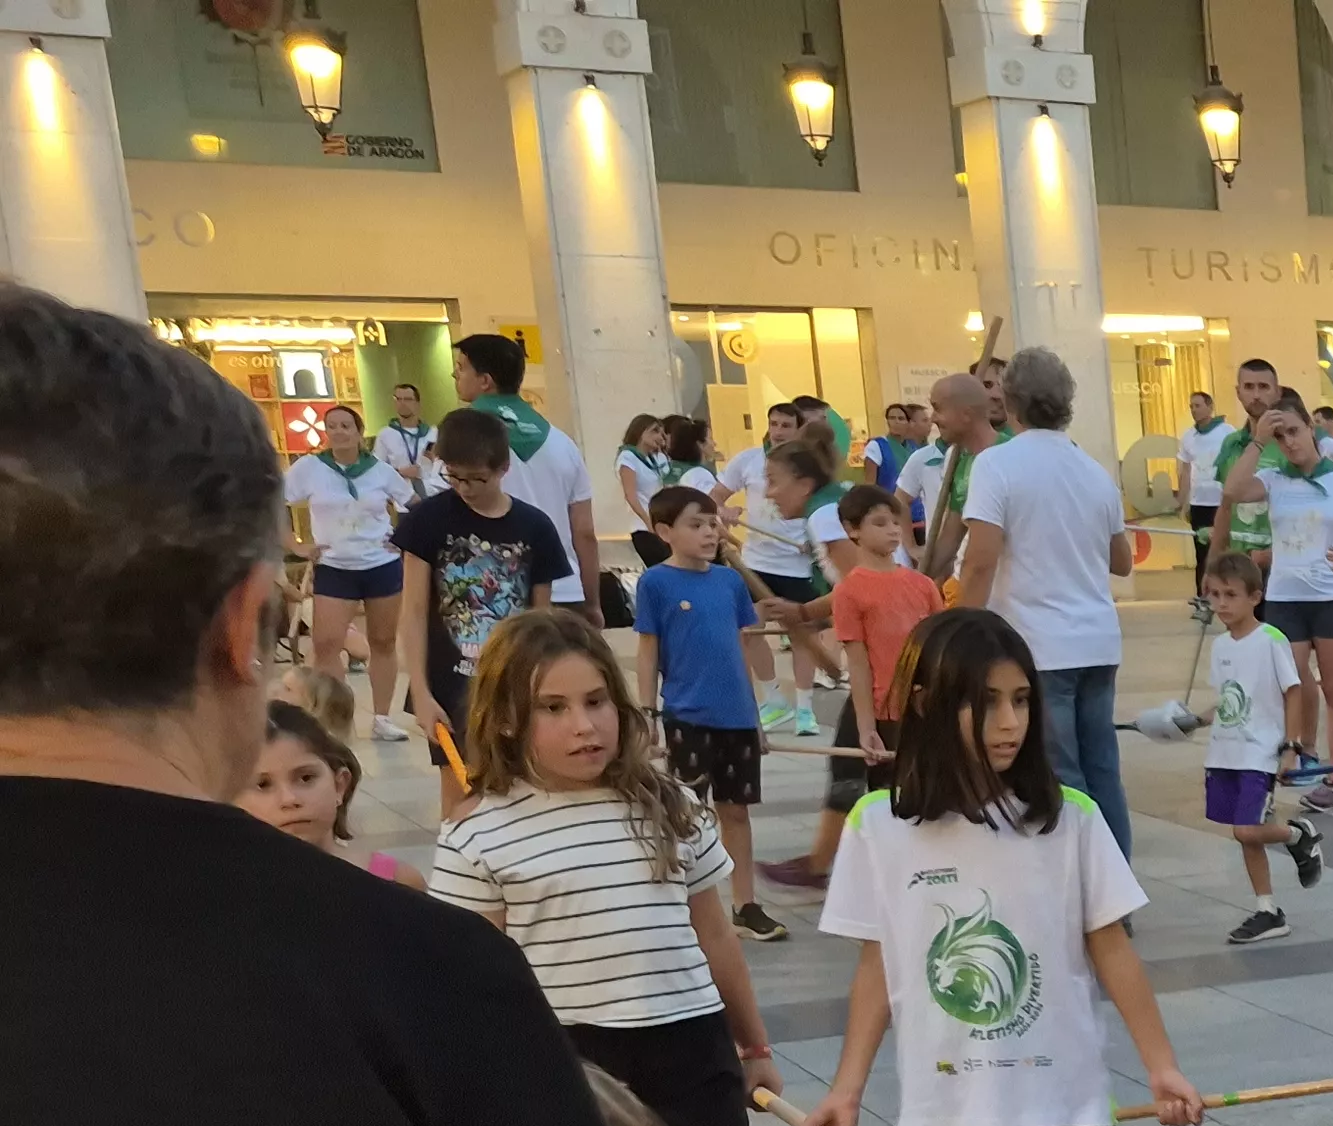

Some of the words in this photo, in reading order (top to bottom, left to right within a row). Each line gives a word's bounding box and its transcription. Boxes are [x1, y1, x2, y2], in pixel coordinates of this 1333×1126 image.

[347, 146, 364, 157] DE
[769, 230, 978, 272] OFICIN
[969, 1013, 1026, 1041] ATLETISMO
[1020, 952, 1042, 1015] DIVERTIDO
